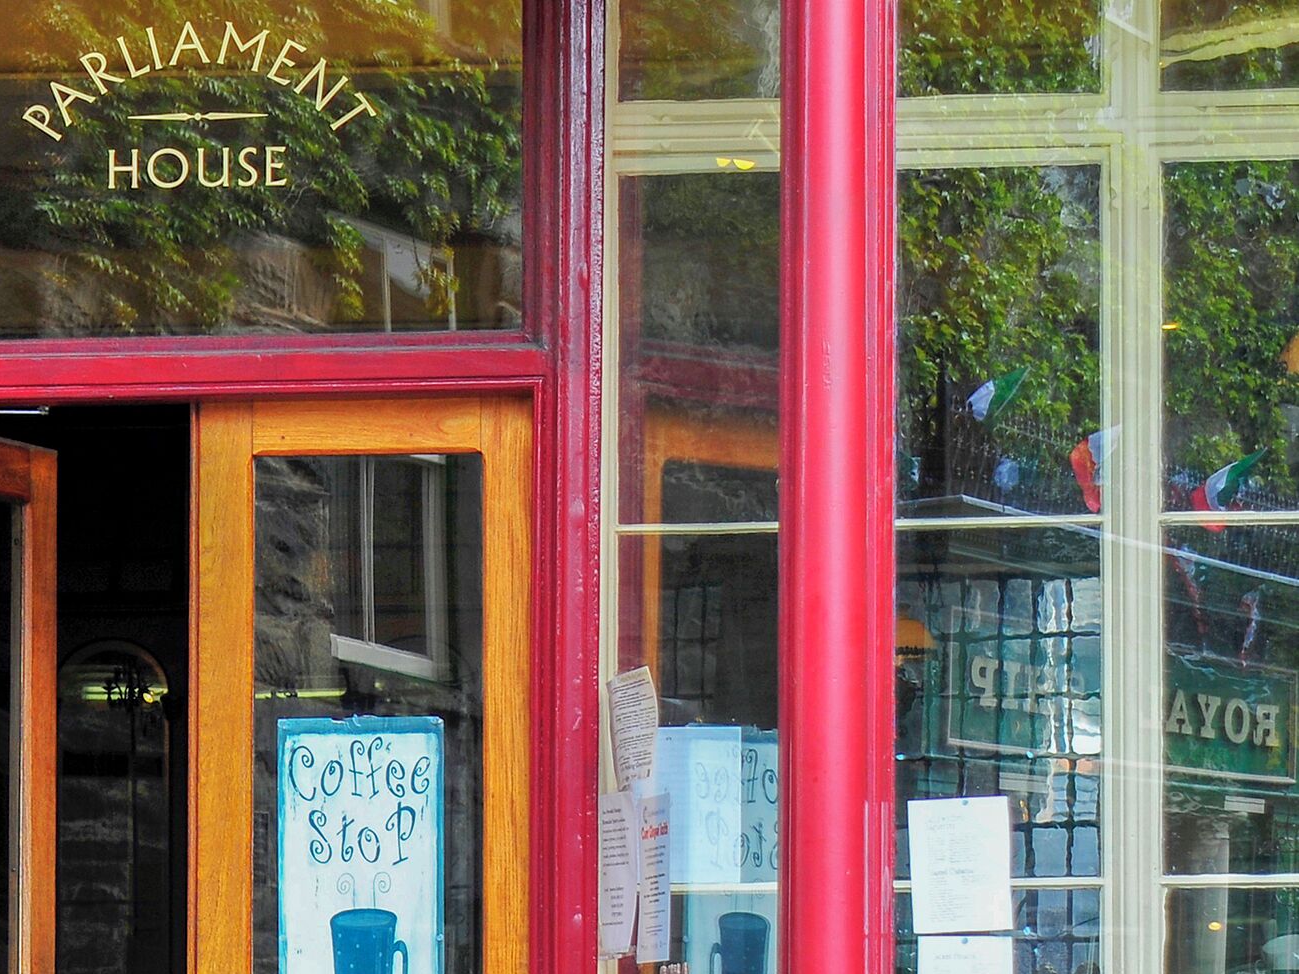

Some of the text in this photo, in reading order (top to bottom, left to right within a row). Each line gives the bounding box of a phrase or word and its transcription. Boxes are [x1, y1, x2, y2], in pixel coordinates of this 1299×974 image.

[22, 21, 377, 142] PARLIAMENT
[107, 146, 288, 189] HOUSE
[288, 736, 431, 802] Coffee
